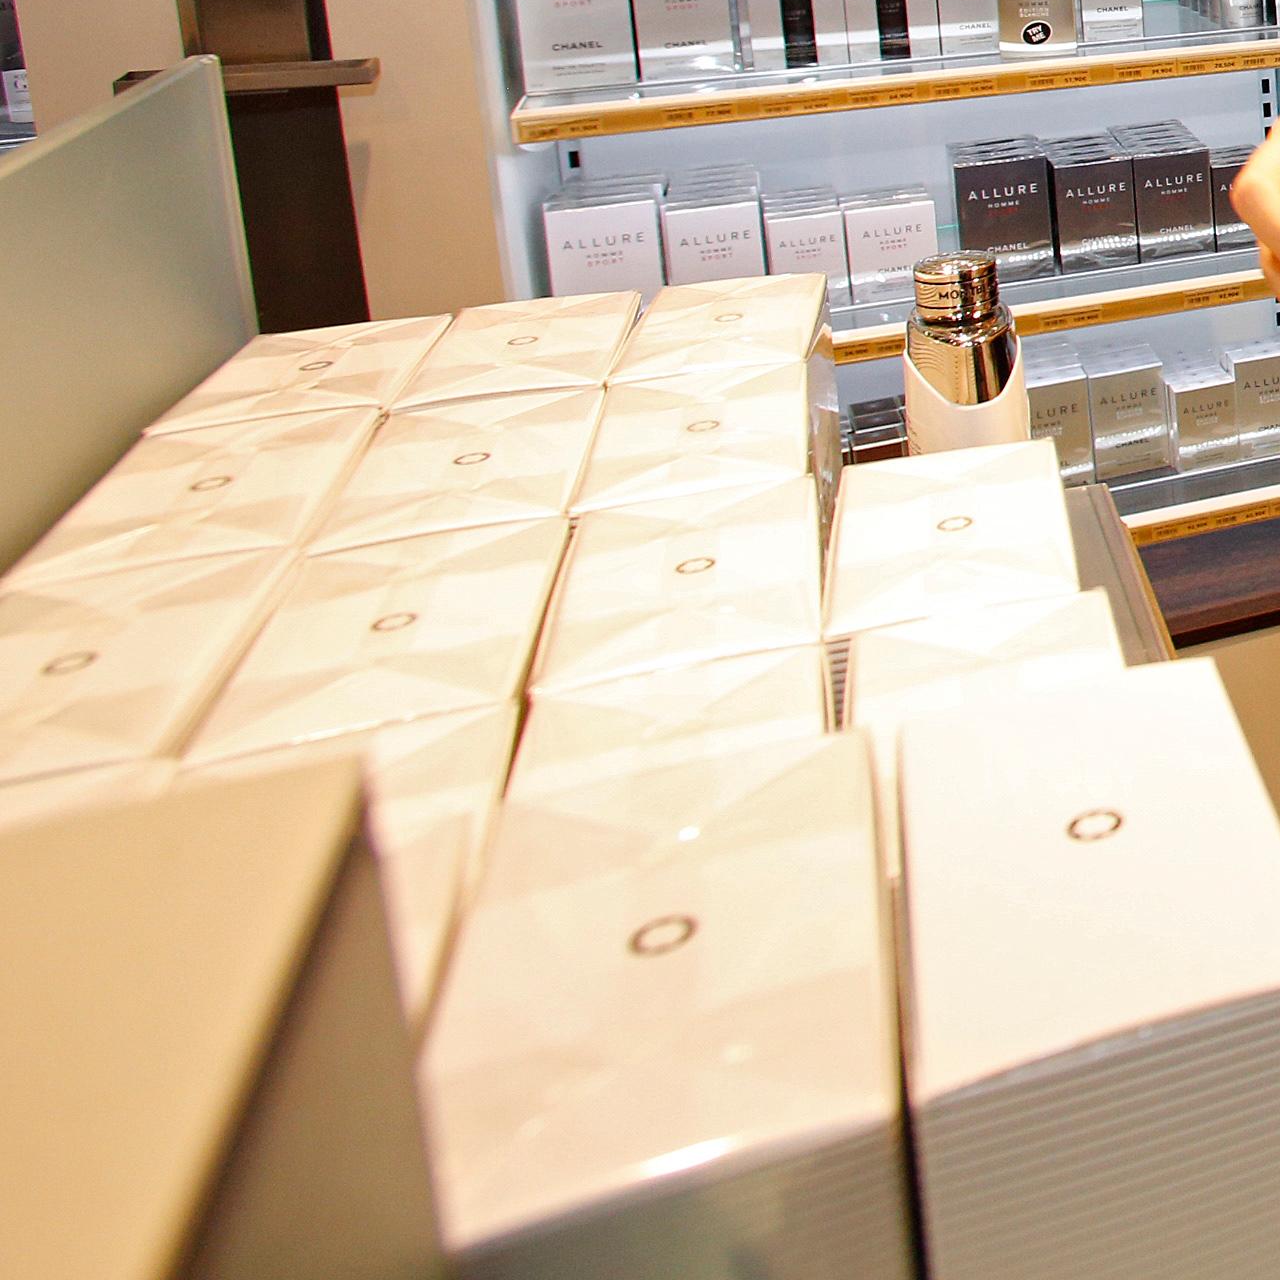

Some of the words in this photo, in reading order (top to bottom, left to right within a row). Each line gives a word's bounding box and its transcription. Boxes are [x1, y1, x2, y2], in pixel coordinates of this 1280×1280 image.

[959, 23, 992, 31] CHANEL
[1027, 26, 1042, 35] TRY
[1032, 33, 1045, 42] ME
[552, 41, 603, 51] CHANEL
[1145, 173, 1203, 189] ALLURE
[968, 183, 1038, 201] ALLURE
[1065, 182, 1126, 198] ALLURE
[1161, 187, 1187, 195] HOMME
[988, 200, 1020, 208] HOMME
[1083, 197, 1110, 205] HOMME
[863, 224, 922, 239] ALLURE
[1160, 224, 1194, 234] CHANEL
[562, 232, 644, 250] ALLURE
[680, 230, 751, 247] ALLURE
[779, 235, 836, 248] ALLURE
[987, 242, 1028, 253] CHANEL
[1101, 388, 1157, 405] ALLURE
[1183, 400, 1229, 414] ALLURE
[1116, 438, 1149, 448] CHANEL
